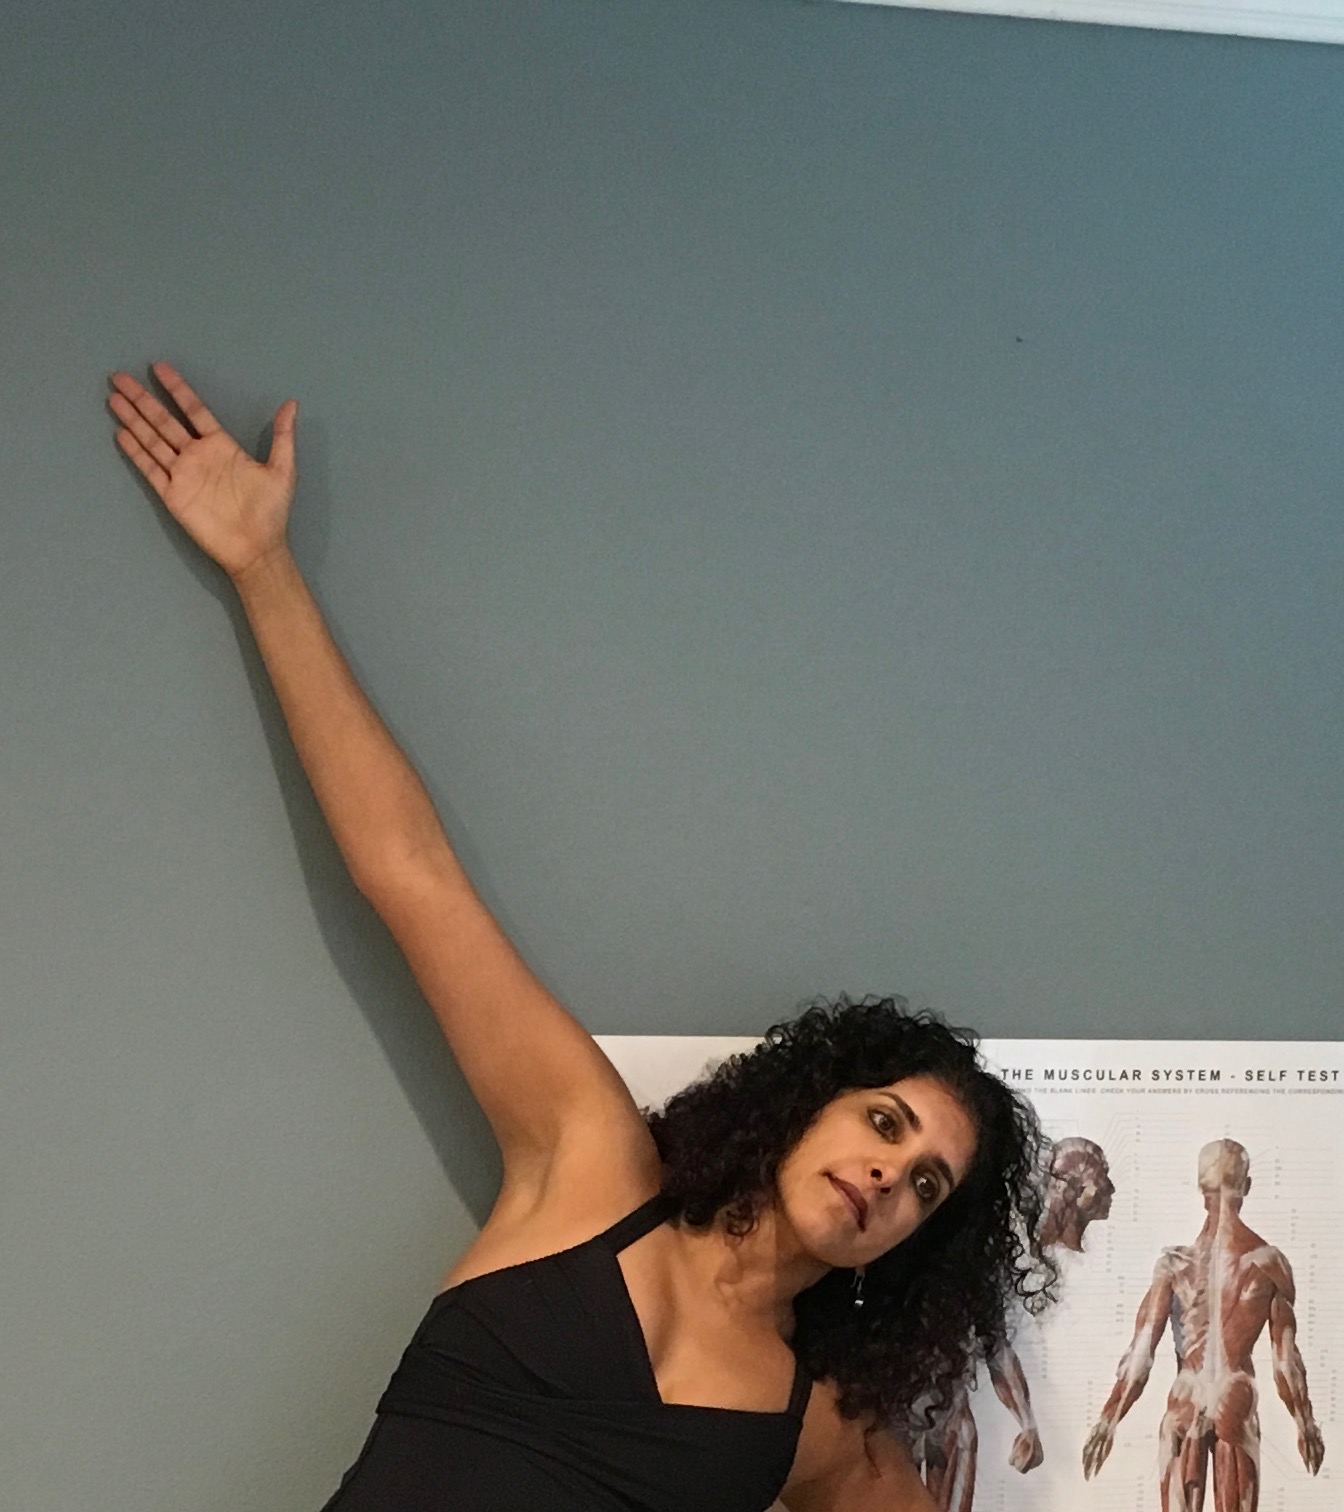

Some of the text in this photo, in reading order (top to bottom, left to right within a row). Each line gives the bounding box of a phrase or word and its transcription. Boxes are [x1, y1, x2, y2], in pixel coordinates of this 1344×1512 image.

[1000, 1068, 1034, 1081] THE
[1043, 1068, 1143, 1081] MUSCULAR
[1151, 1069, 1222, 1082] SYSTEM
[1244, 1069, 1288, 1082] SELF
[1296, 1069, 1341, 1082] TEST
